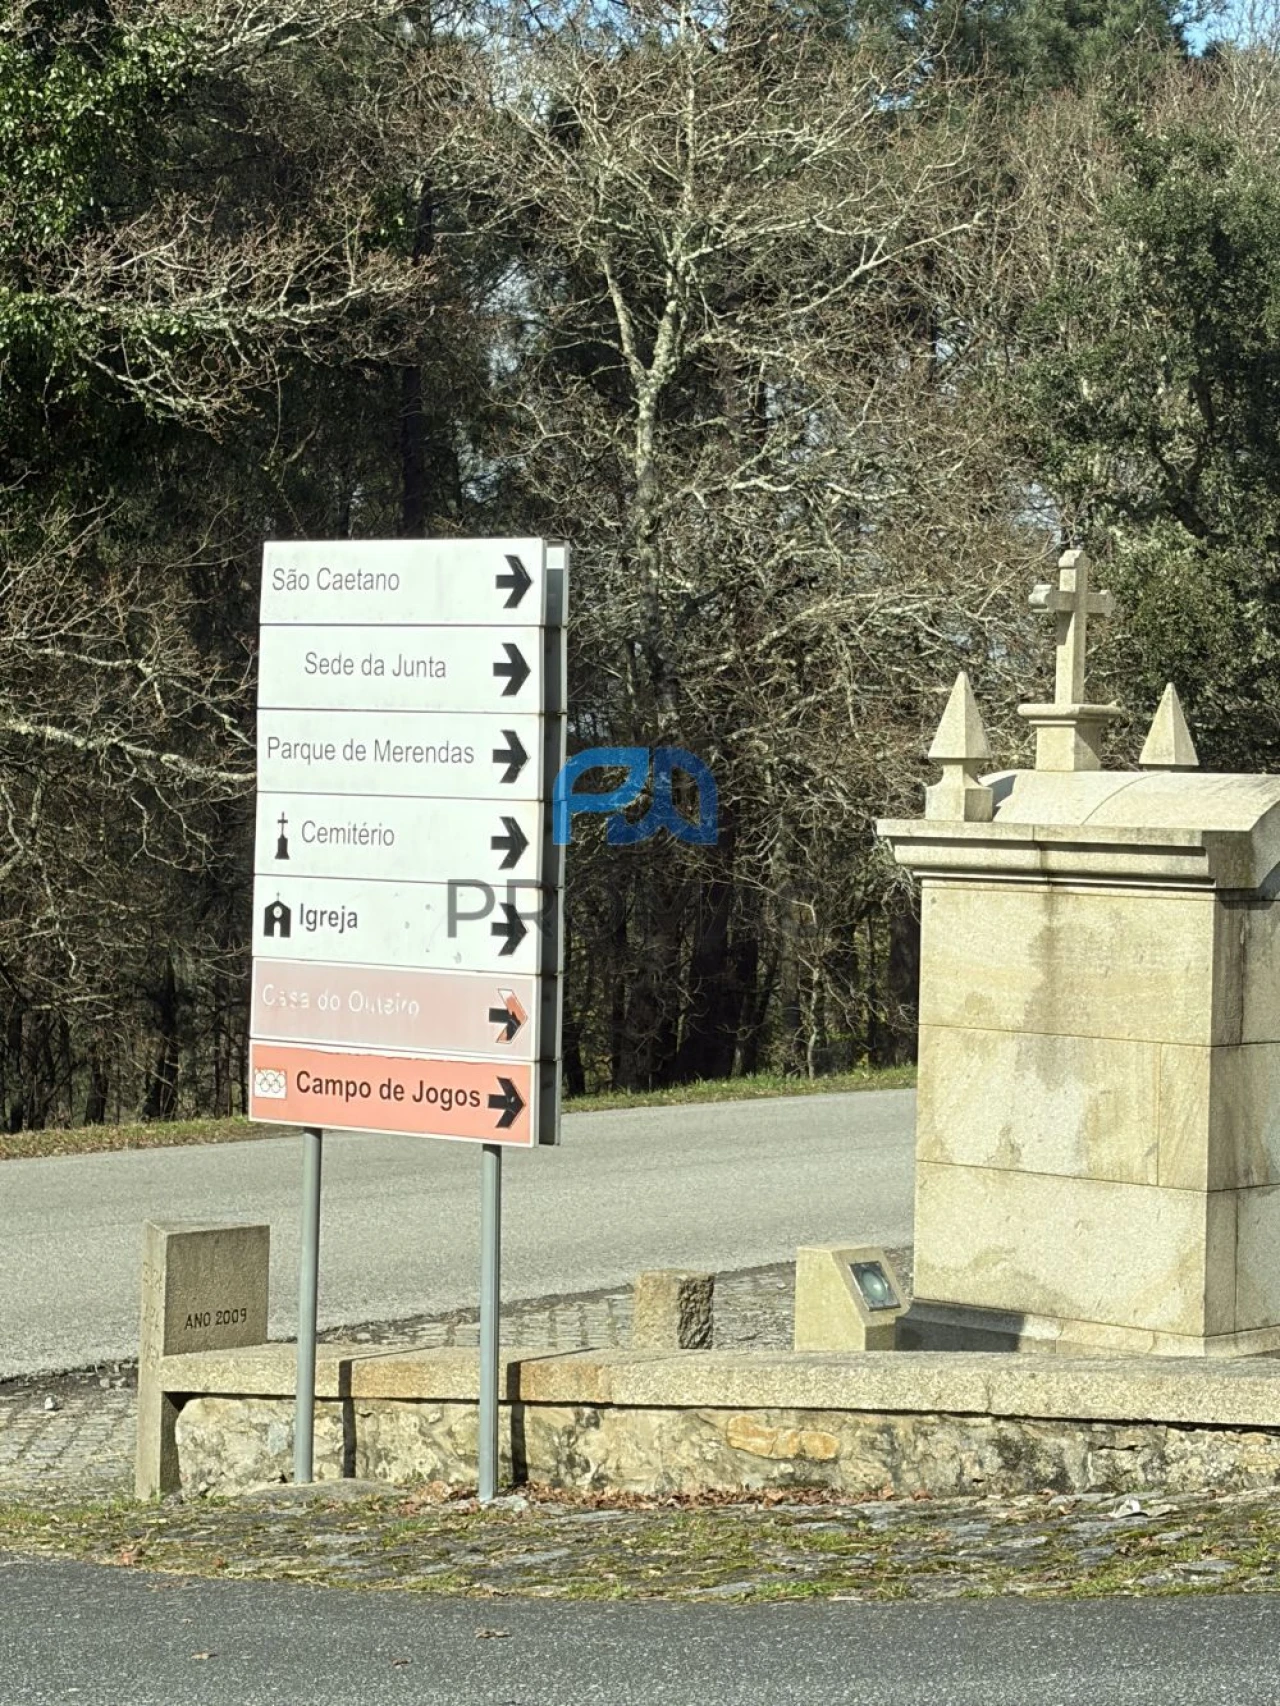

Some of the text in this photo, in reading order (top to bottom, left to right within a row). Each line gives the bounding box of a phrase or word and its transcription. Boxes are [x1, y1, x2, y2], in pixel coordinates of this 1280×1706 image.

[272, 566, 400, 591] São Caetano
[304, 651, 447, 679] Sede da Junta
[267, 736, 475, 765] Parque de Merendas
[301, 820, 395, 847] Cemitério
[299, 902, 358, 935] Igreja
[262, 983, 310, 1009] Casa
[317, 990, 341, 1011] do
[296, 1070, 481, 1113] Campo de Jogos
[185, 1308, 247, 1330] ANO 2009
